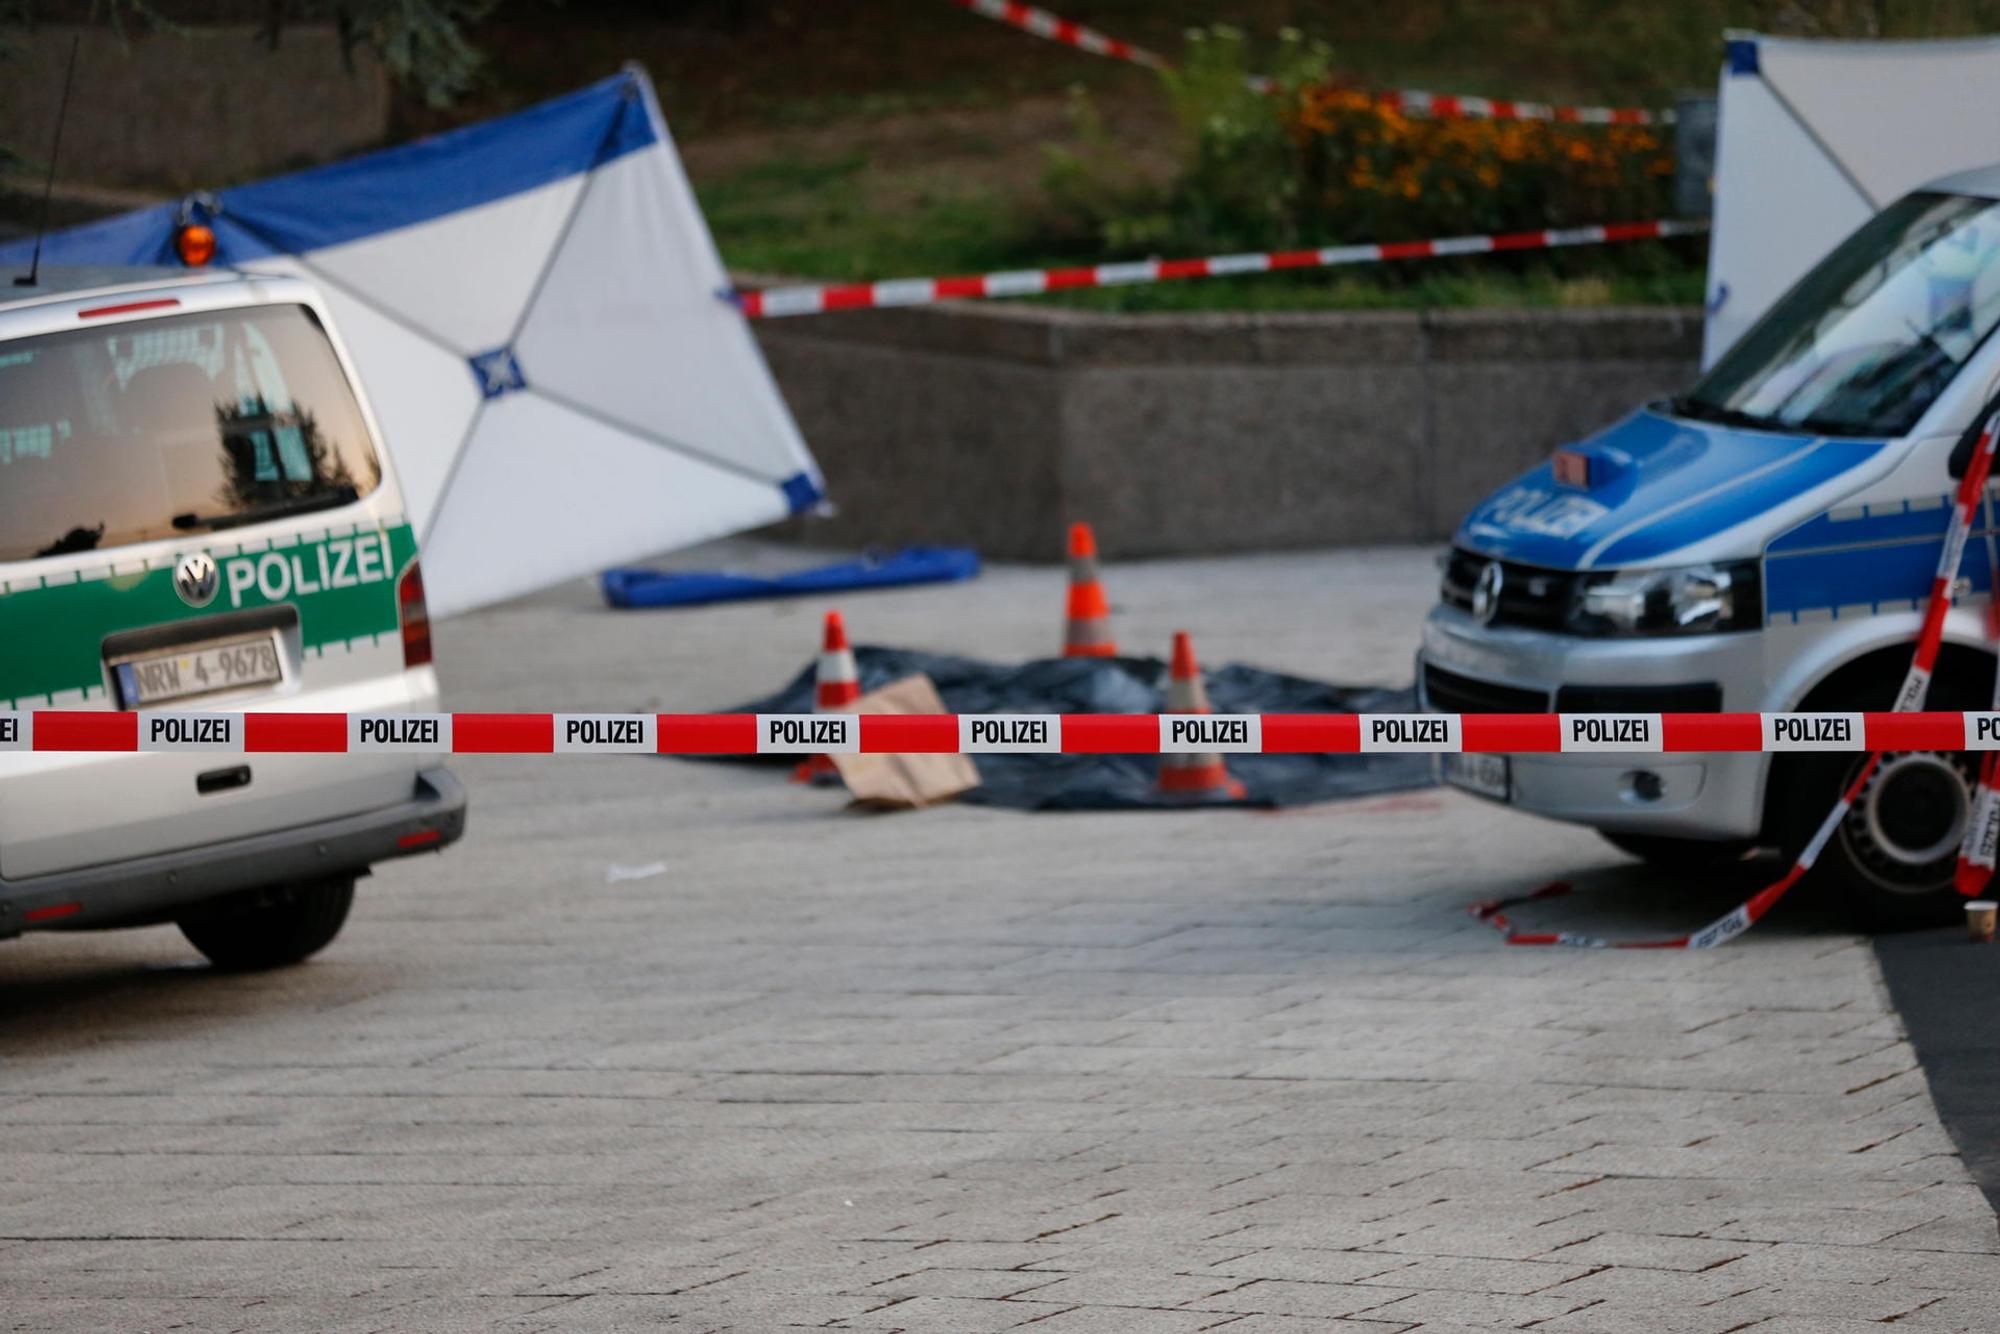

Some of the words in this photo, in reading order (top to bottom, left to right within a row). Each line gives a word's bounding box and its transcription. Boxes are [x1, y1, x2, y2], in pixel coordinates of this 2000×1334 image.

[226, 535, 393, 608] POLIZEI
[136, 658, 182, 698] NRW
[151, 719, 230, 743] POLIZEI
[360, 719, 438, 743] POLIZEI
[566, 719, 643, 743] POLIZEI
[770, 719, 847, 743] POLIZEI
[971, 719, 1047, 743] POLIZEI
[1172, 719, 1248, 742] POLIZEI
[1372, 718, 1448, 742] POLIZEI
[1572, 718, 1649, 742] POLIZEI
[1774, 717, 1851, 741] POLIZEI
